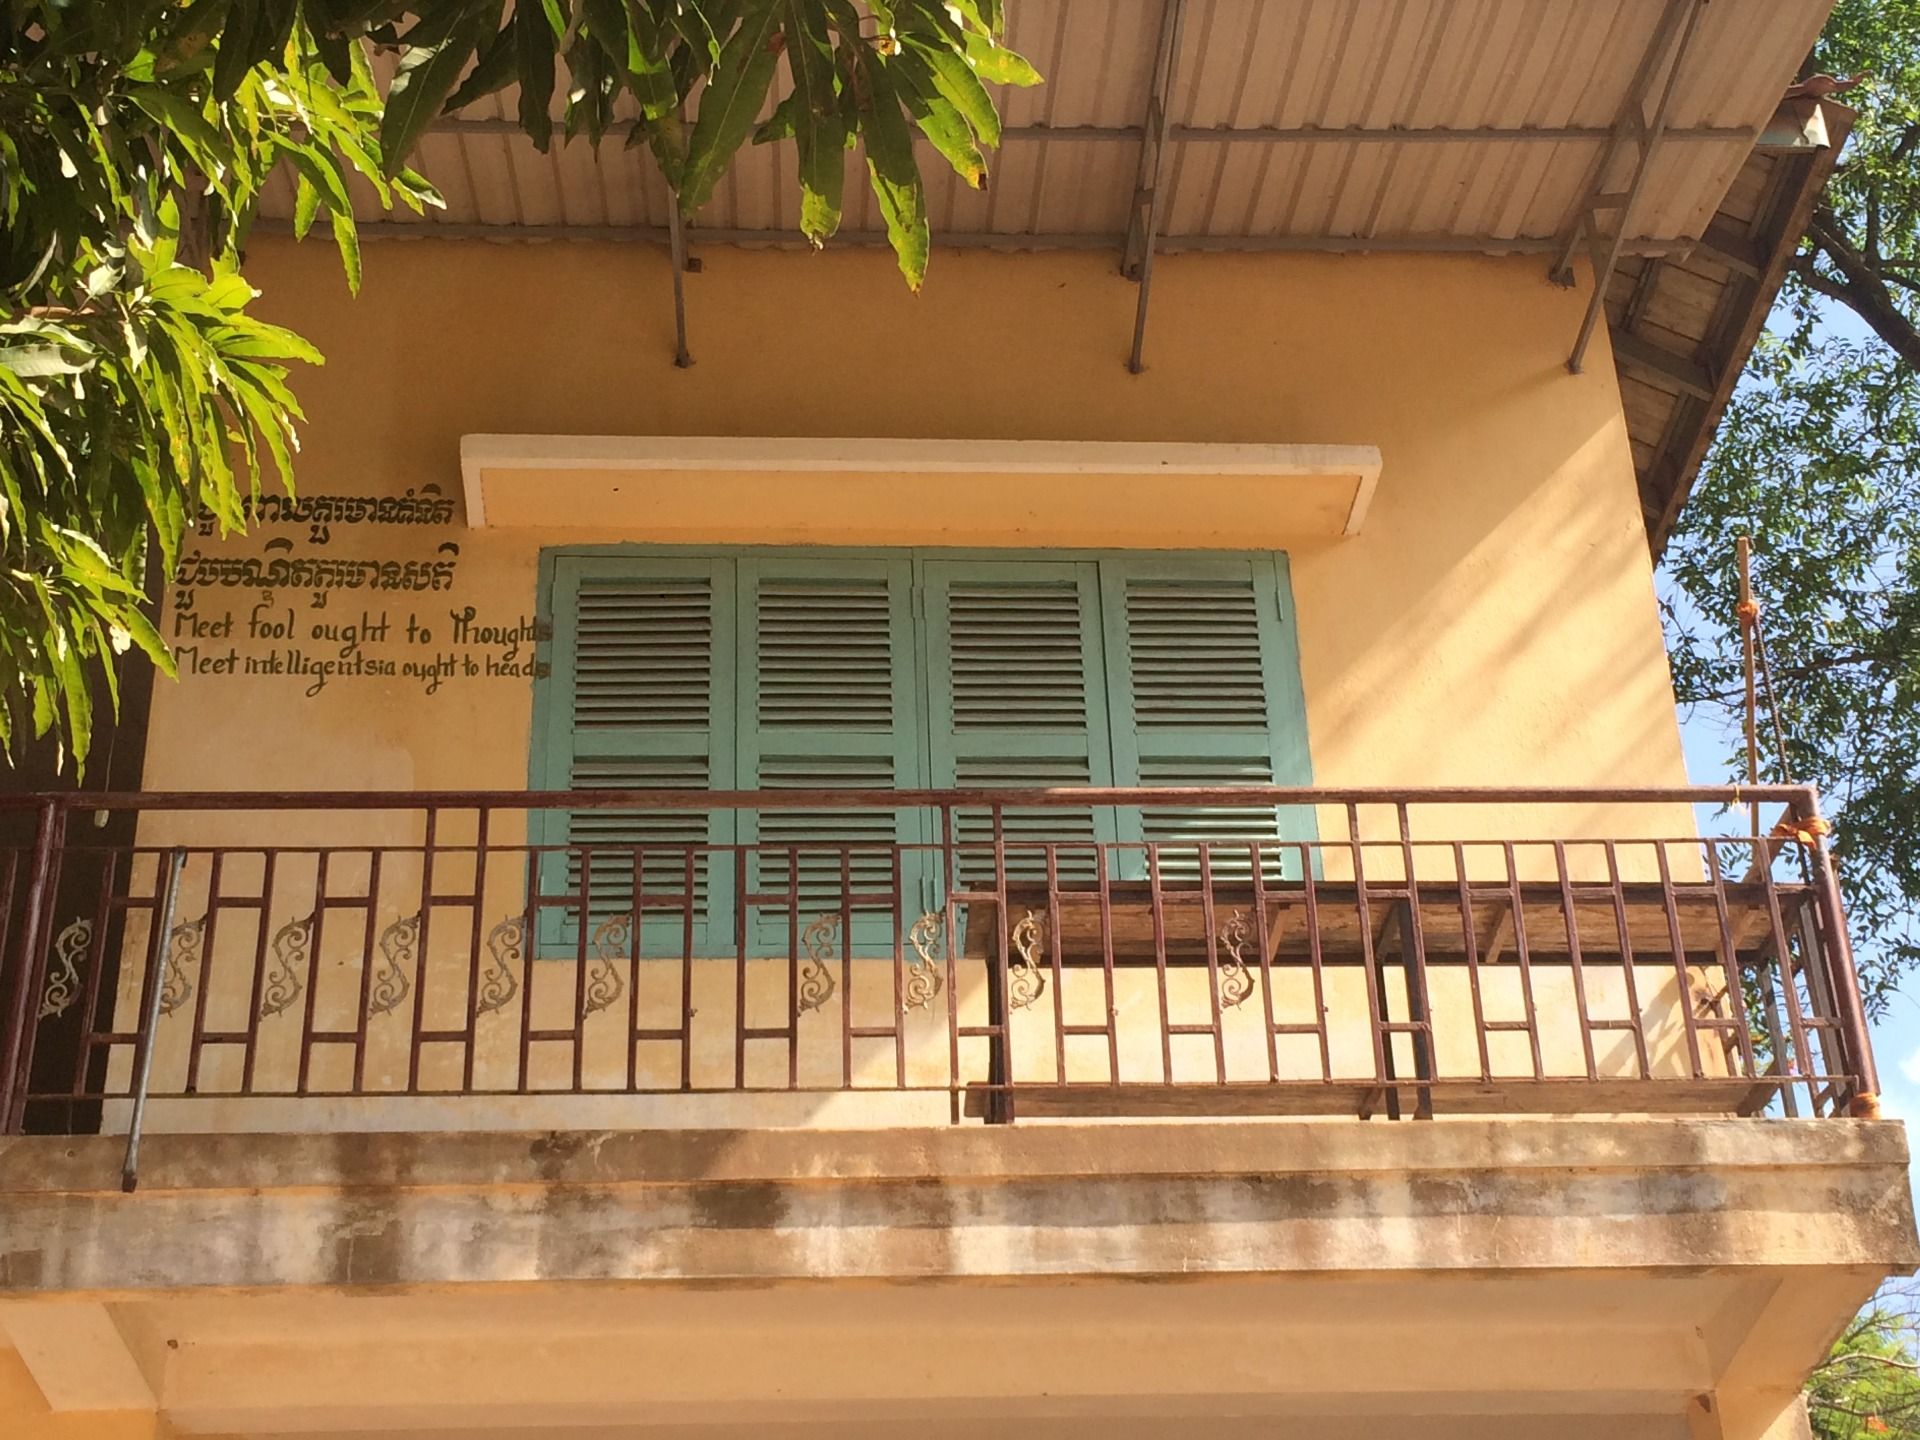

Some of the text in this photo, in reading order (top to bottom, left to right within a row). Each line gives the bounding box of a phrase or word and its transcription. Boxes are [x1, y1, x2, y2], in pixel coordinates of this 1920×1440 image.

[174, 611, 234, 638] Meet
[248, 603, 295, 639] fool
[311, 610, 391, 659] ought
[406, 612, 432, 644] to
[174, 646, 240, 675] Meet
[244, 649, 397, 697] intelligentsia
[402, 652, 458, 695] ought
[461, 653, 480, 677] to
